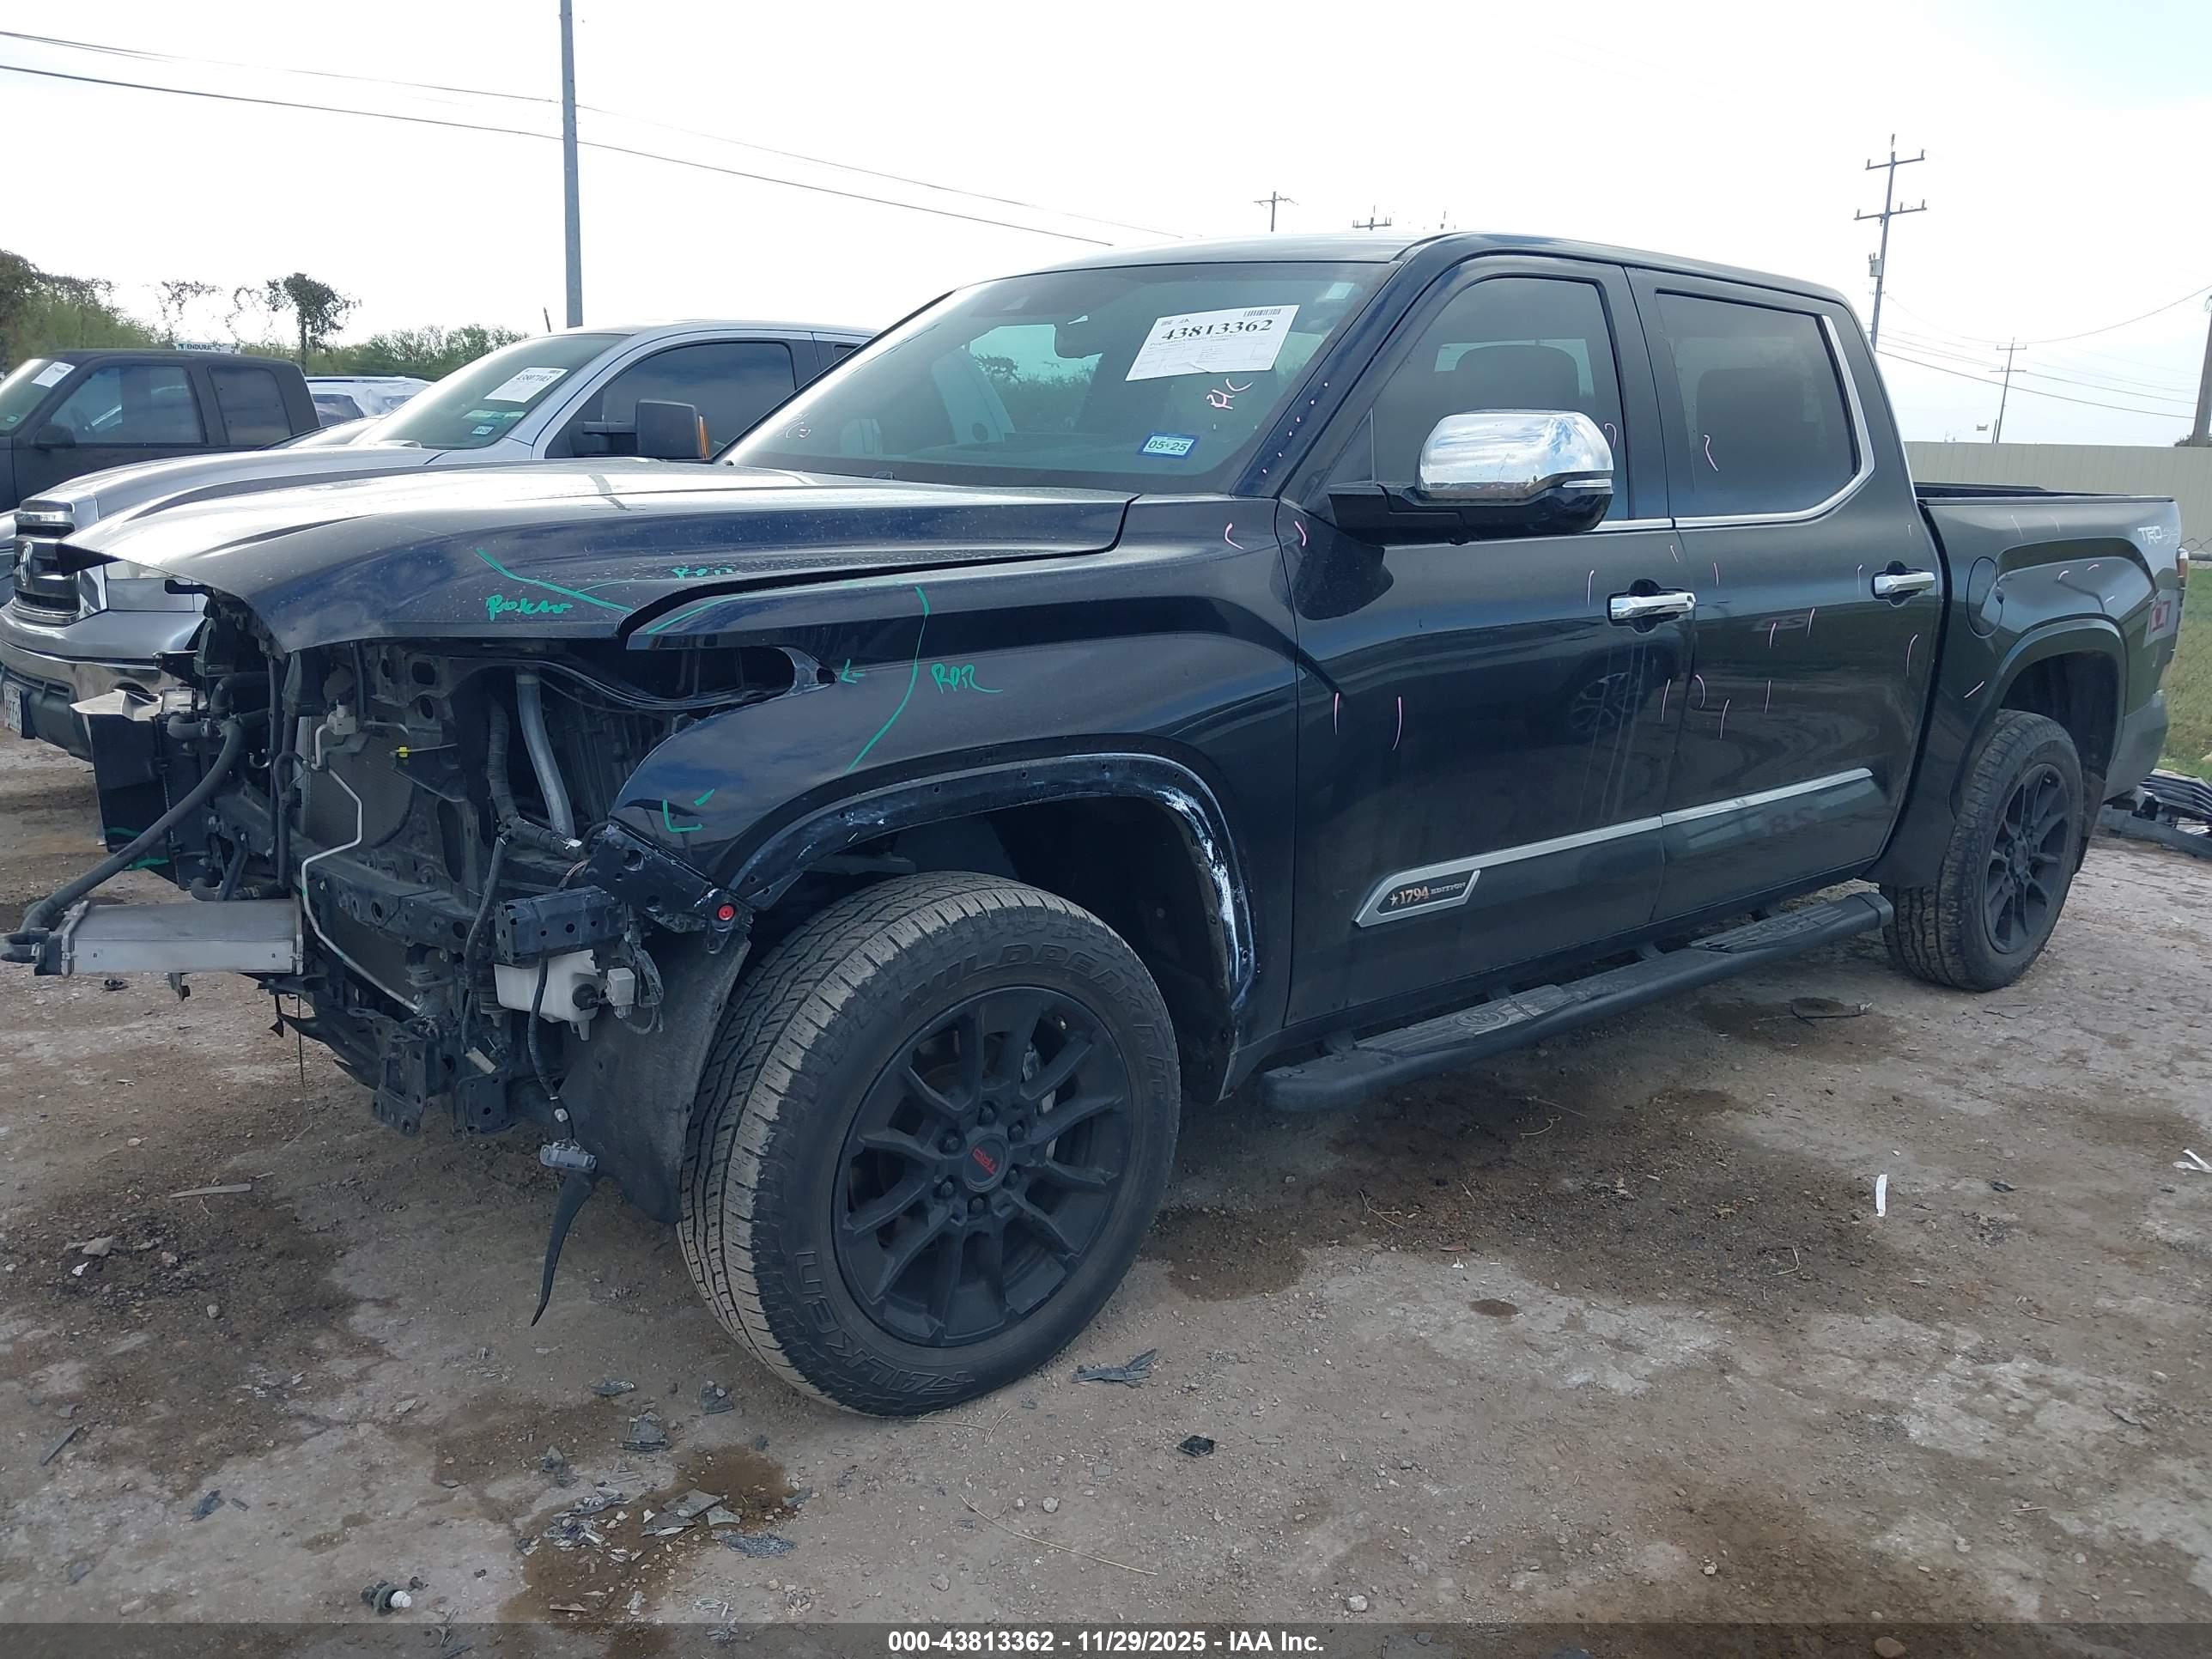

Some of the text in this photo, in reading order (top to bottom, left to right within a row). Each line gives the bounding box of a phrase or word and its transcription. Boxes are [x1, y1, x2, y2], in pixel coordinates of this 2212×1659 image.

[1161, 319, 1273, 341] 43813362
[1148, 441, 1189, 452] 05 25
[2136, 525, 2163, 545] TRD
[1400, 881, 1467, 904] 1794 EDITION
[972, 1147, 997, 1176] TRD
